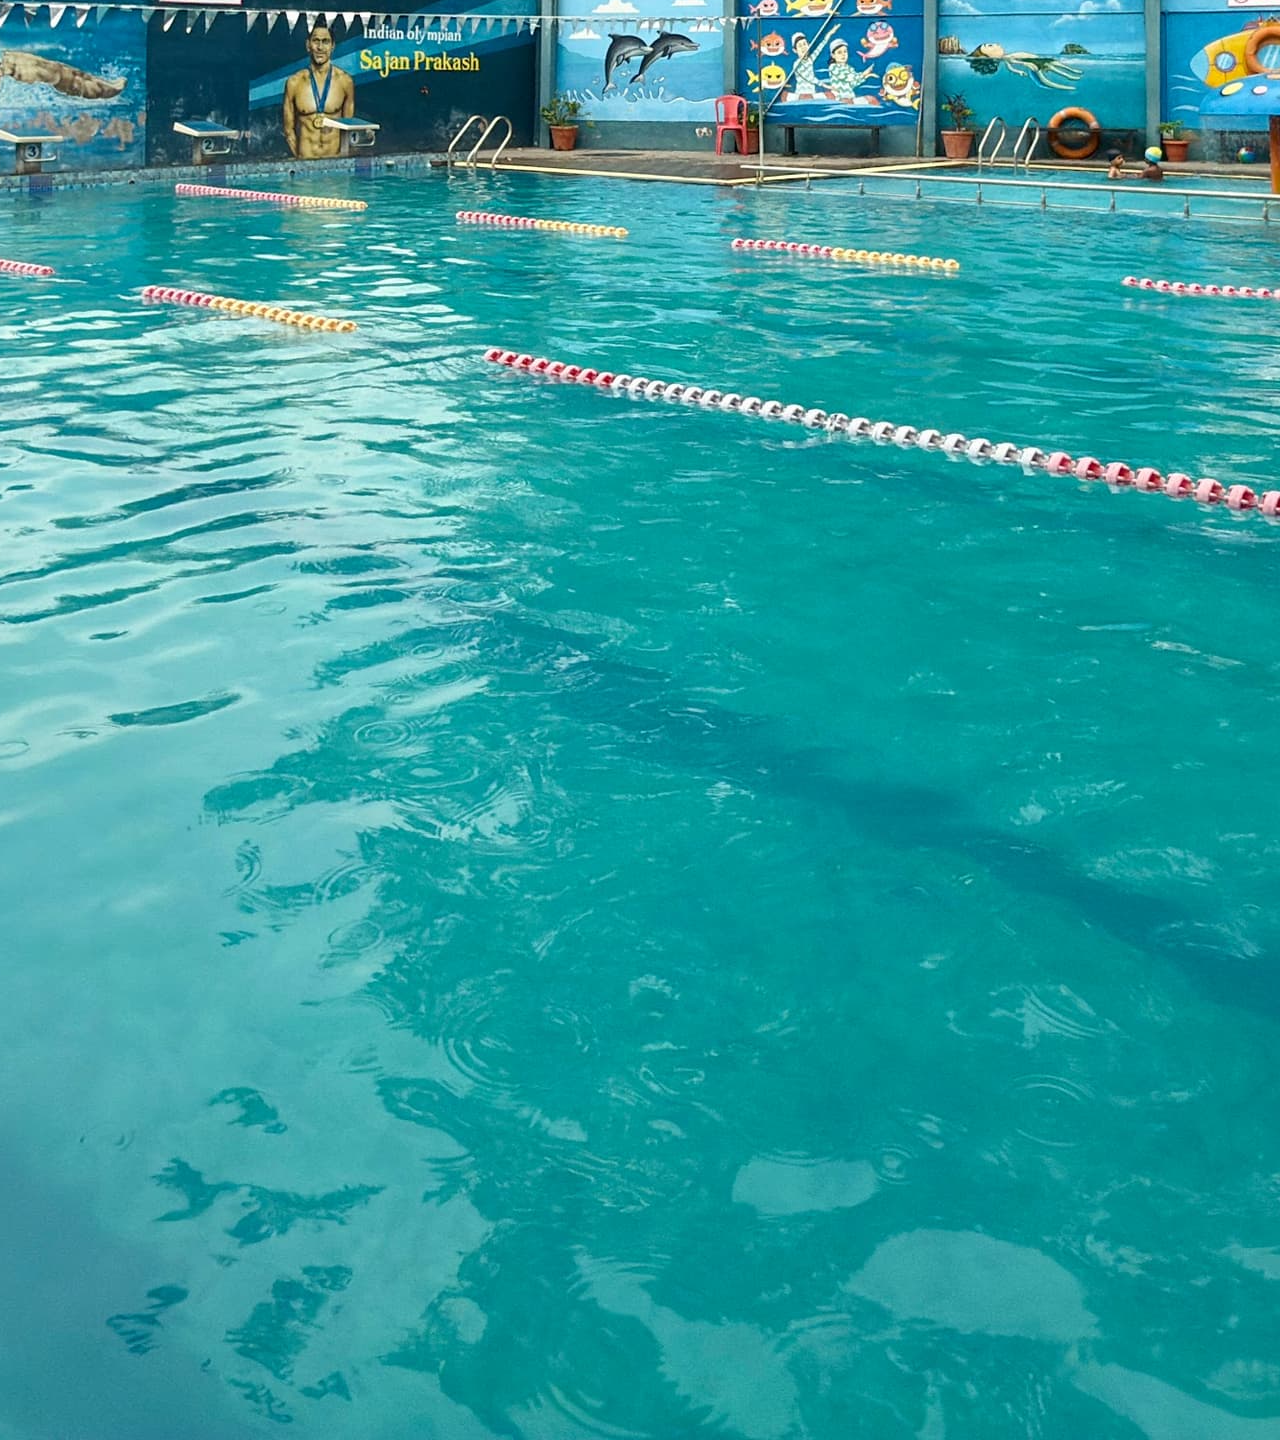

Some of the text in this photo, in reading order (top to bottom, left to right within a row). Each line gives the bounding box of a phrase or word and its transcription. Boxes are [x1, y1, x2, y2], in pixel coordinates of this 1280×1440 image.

[363, 23, 404, 40] Indian
[360, 48, 480, 78] Sajan Prakash
[27, 145, 36, 157] 3
[204, 139, 212, 150] 2
